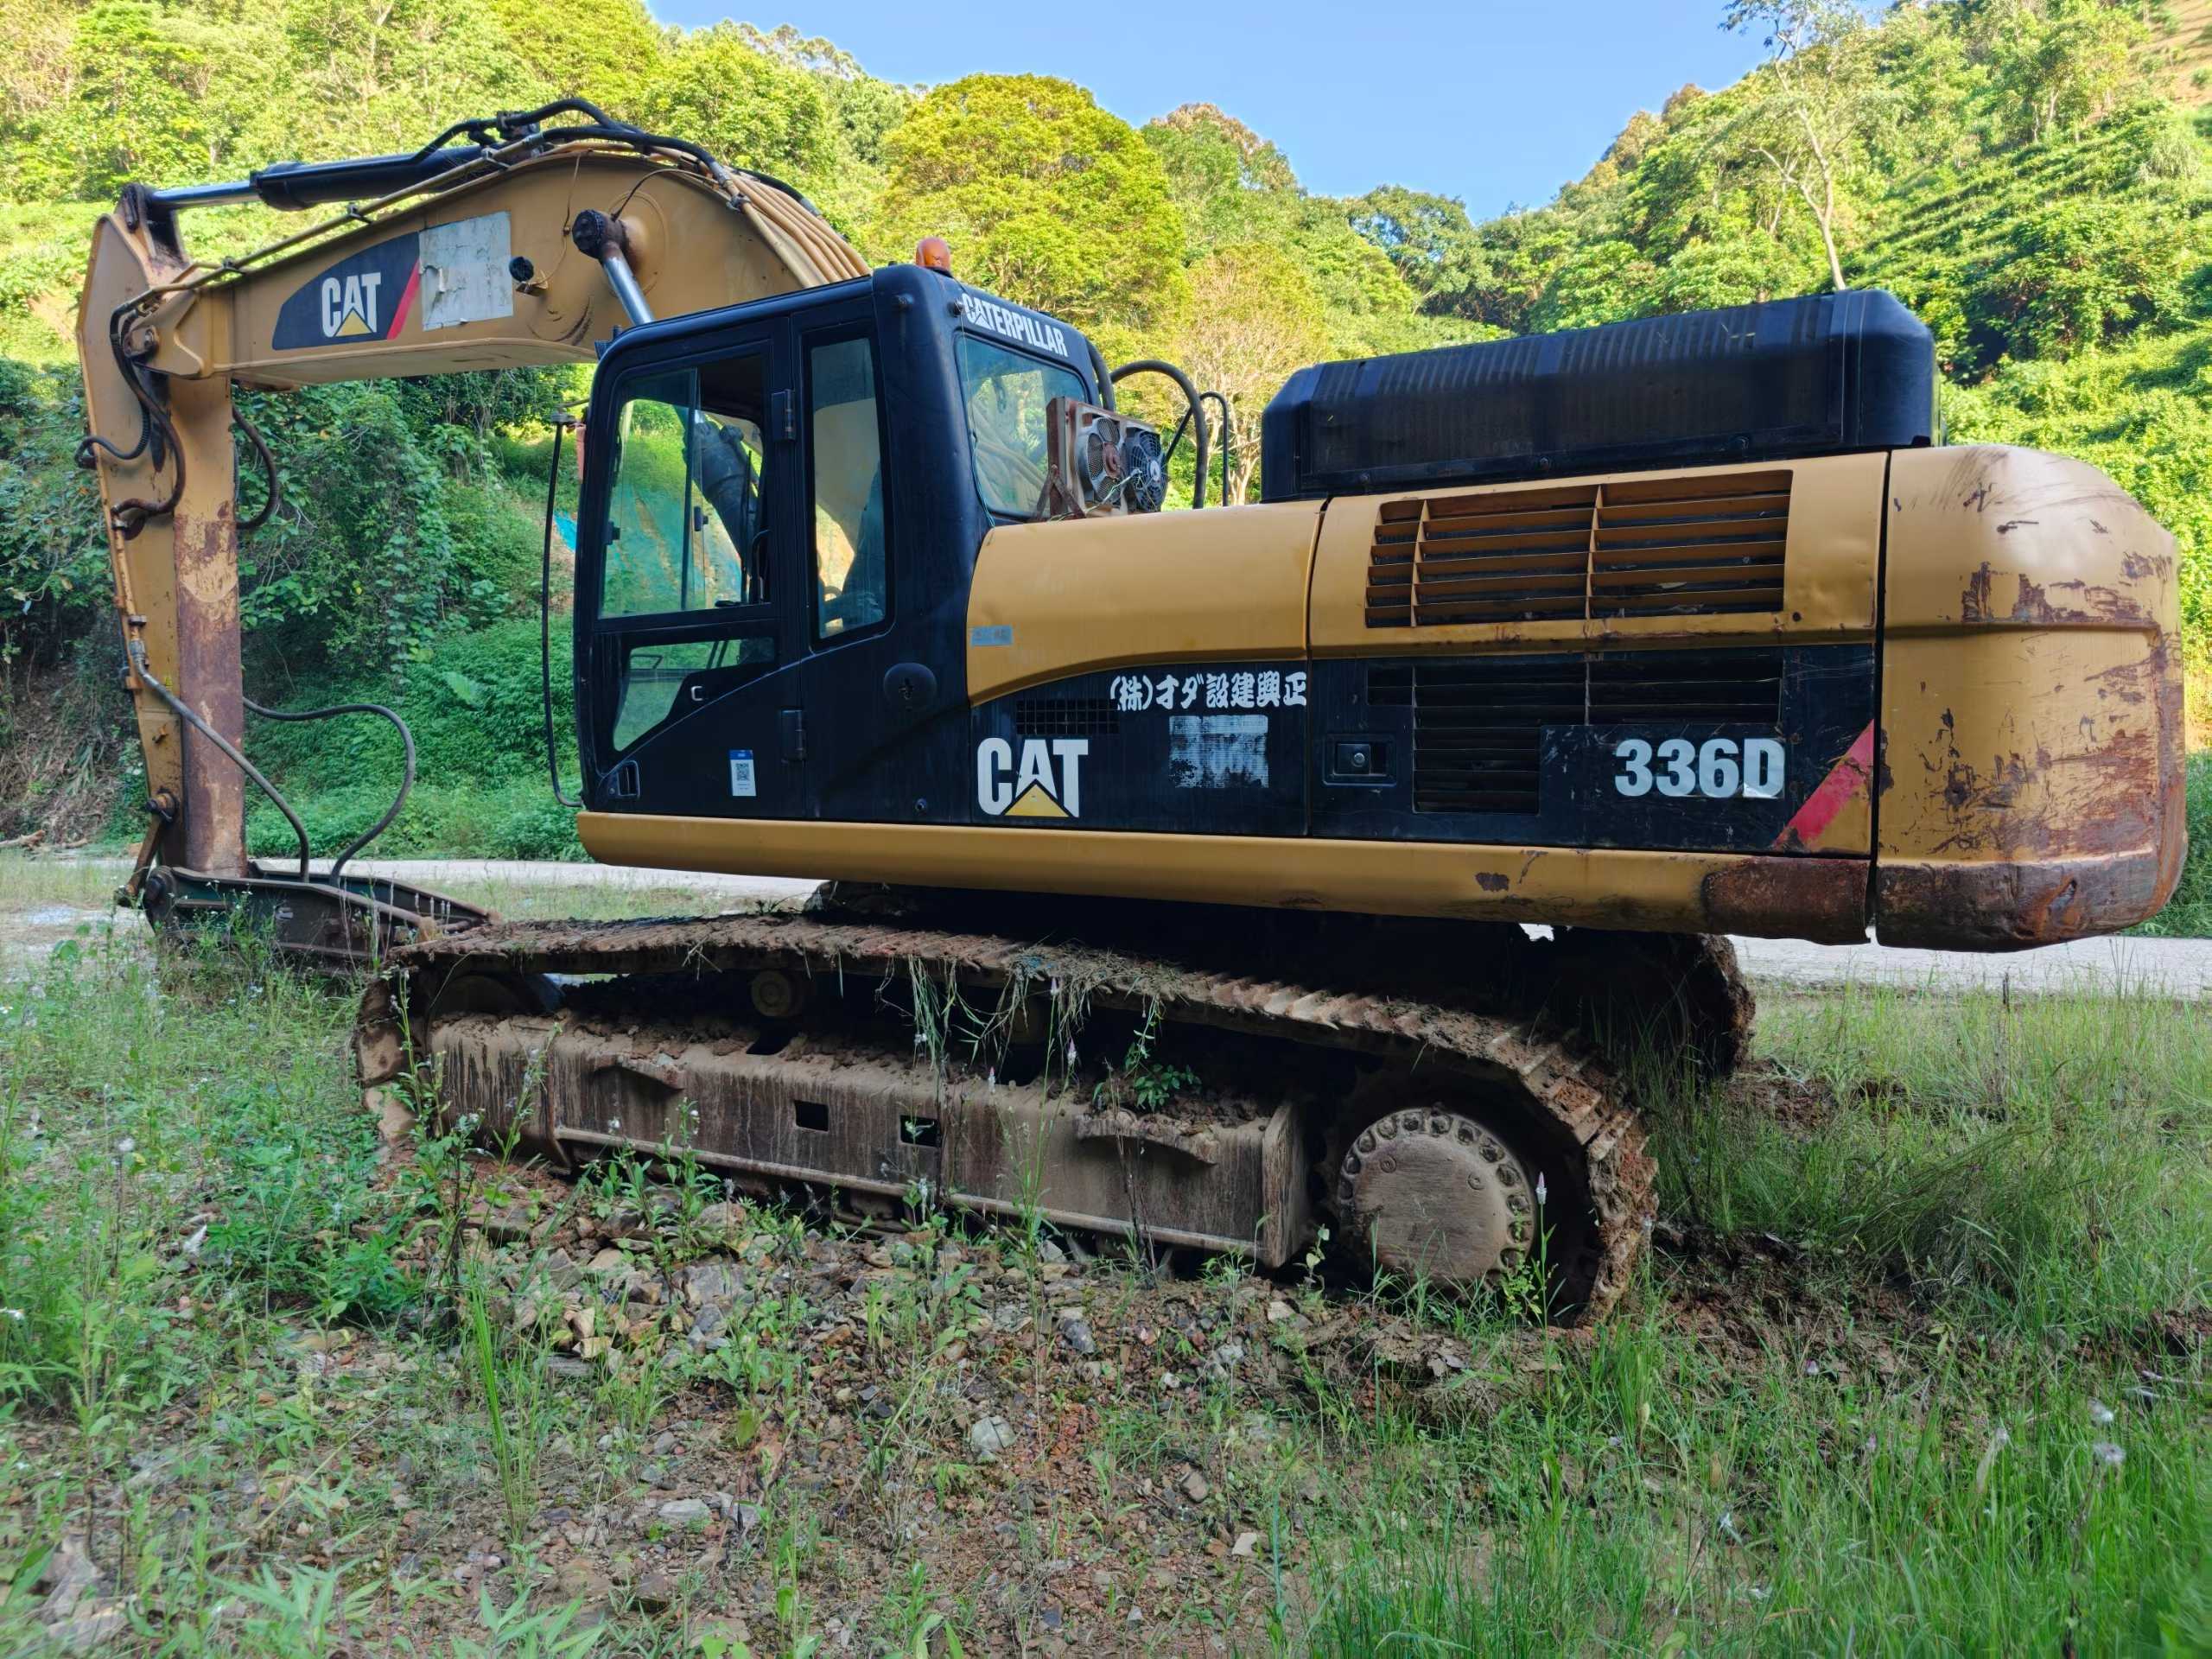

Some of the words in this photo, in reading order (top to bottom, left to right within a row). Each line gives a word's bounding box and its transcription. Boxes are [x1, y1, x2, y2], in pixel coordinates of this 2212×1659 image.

[321, 272, 381, 338] CAT
[961, 293, 1069, 357] CATERPILLAR
[977, 737, 1089, 817] CAT
[1615, 738, 1785, 798] 336D
